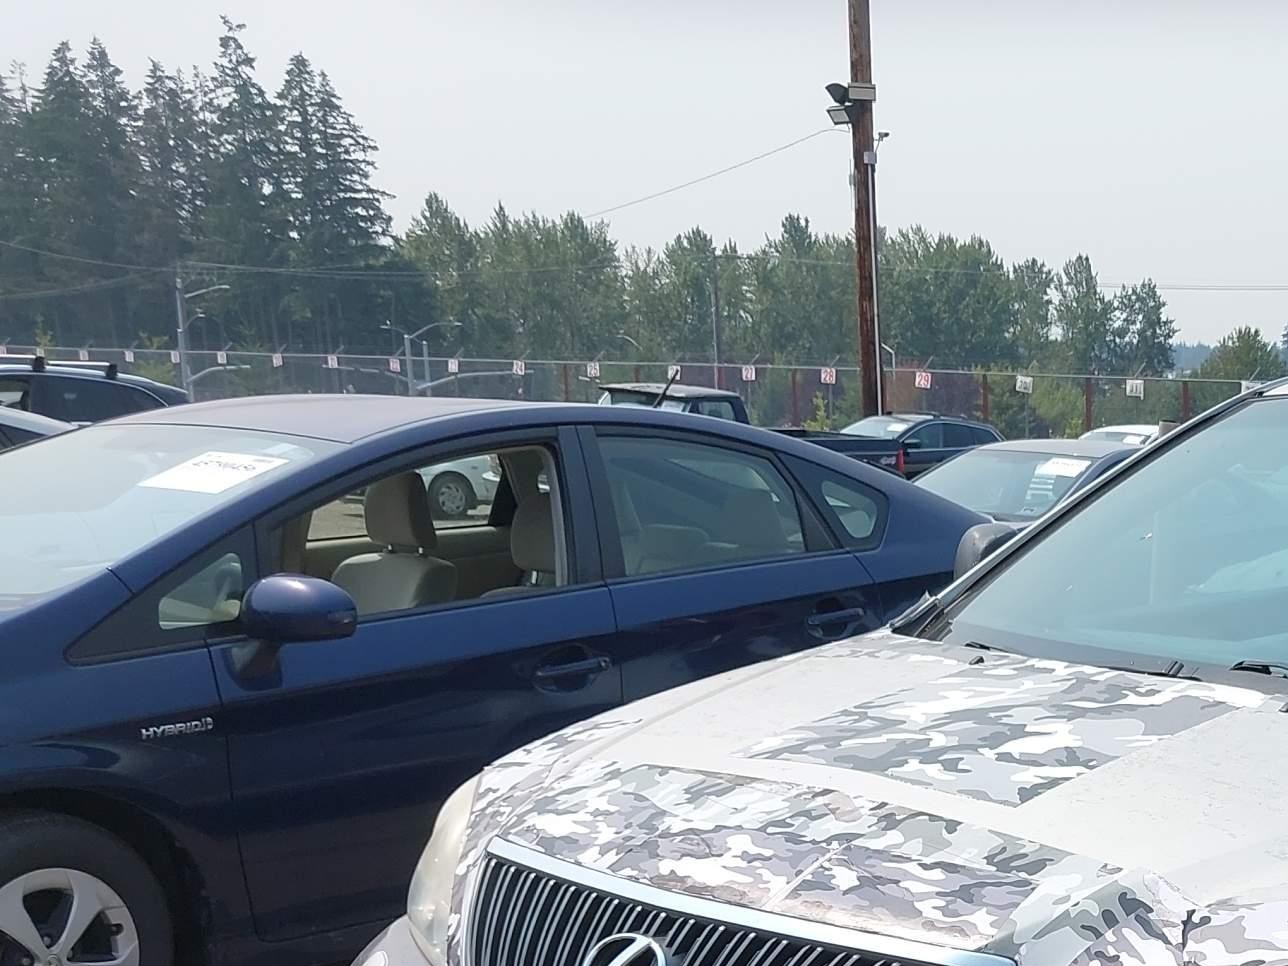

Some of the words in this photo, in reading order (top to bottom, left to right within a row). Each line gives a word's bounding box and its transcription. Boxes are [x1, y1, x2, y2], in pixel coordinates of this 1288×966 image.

[822, 369, 834, 382] 28
[917, 373, 929, 387] 29
[141, 720, 202, 740] HYBRID
